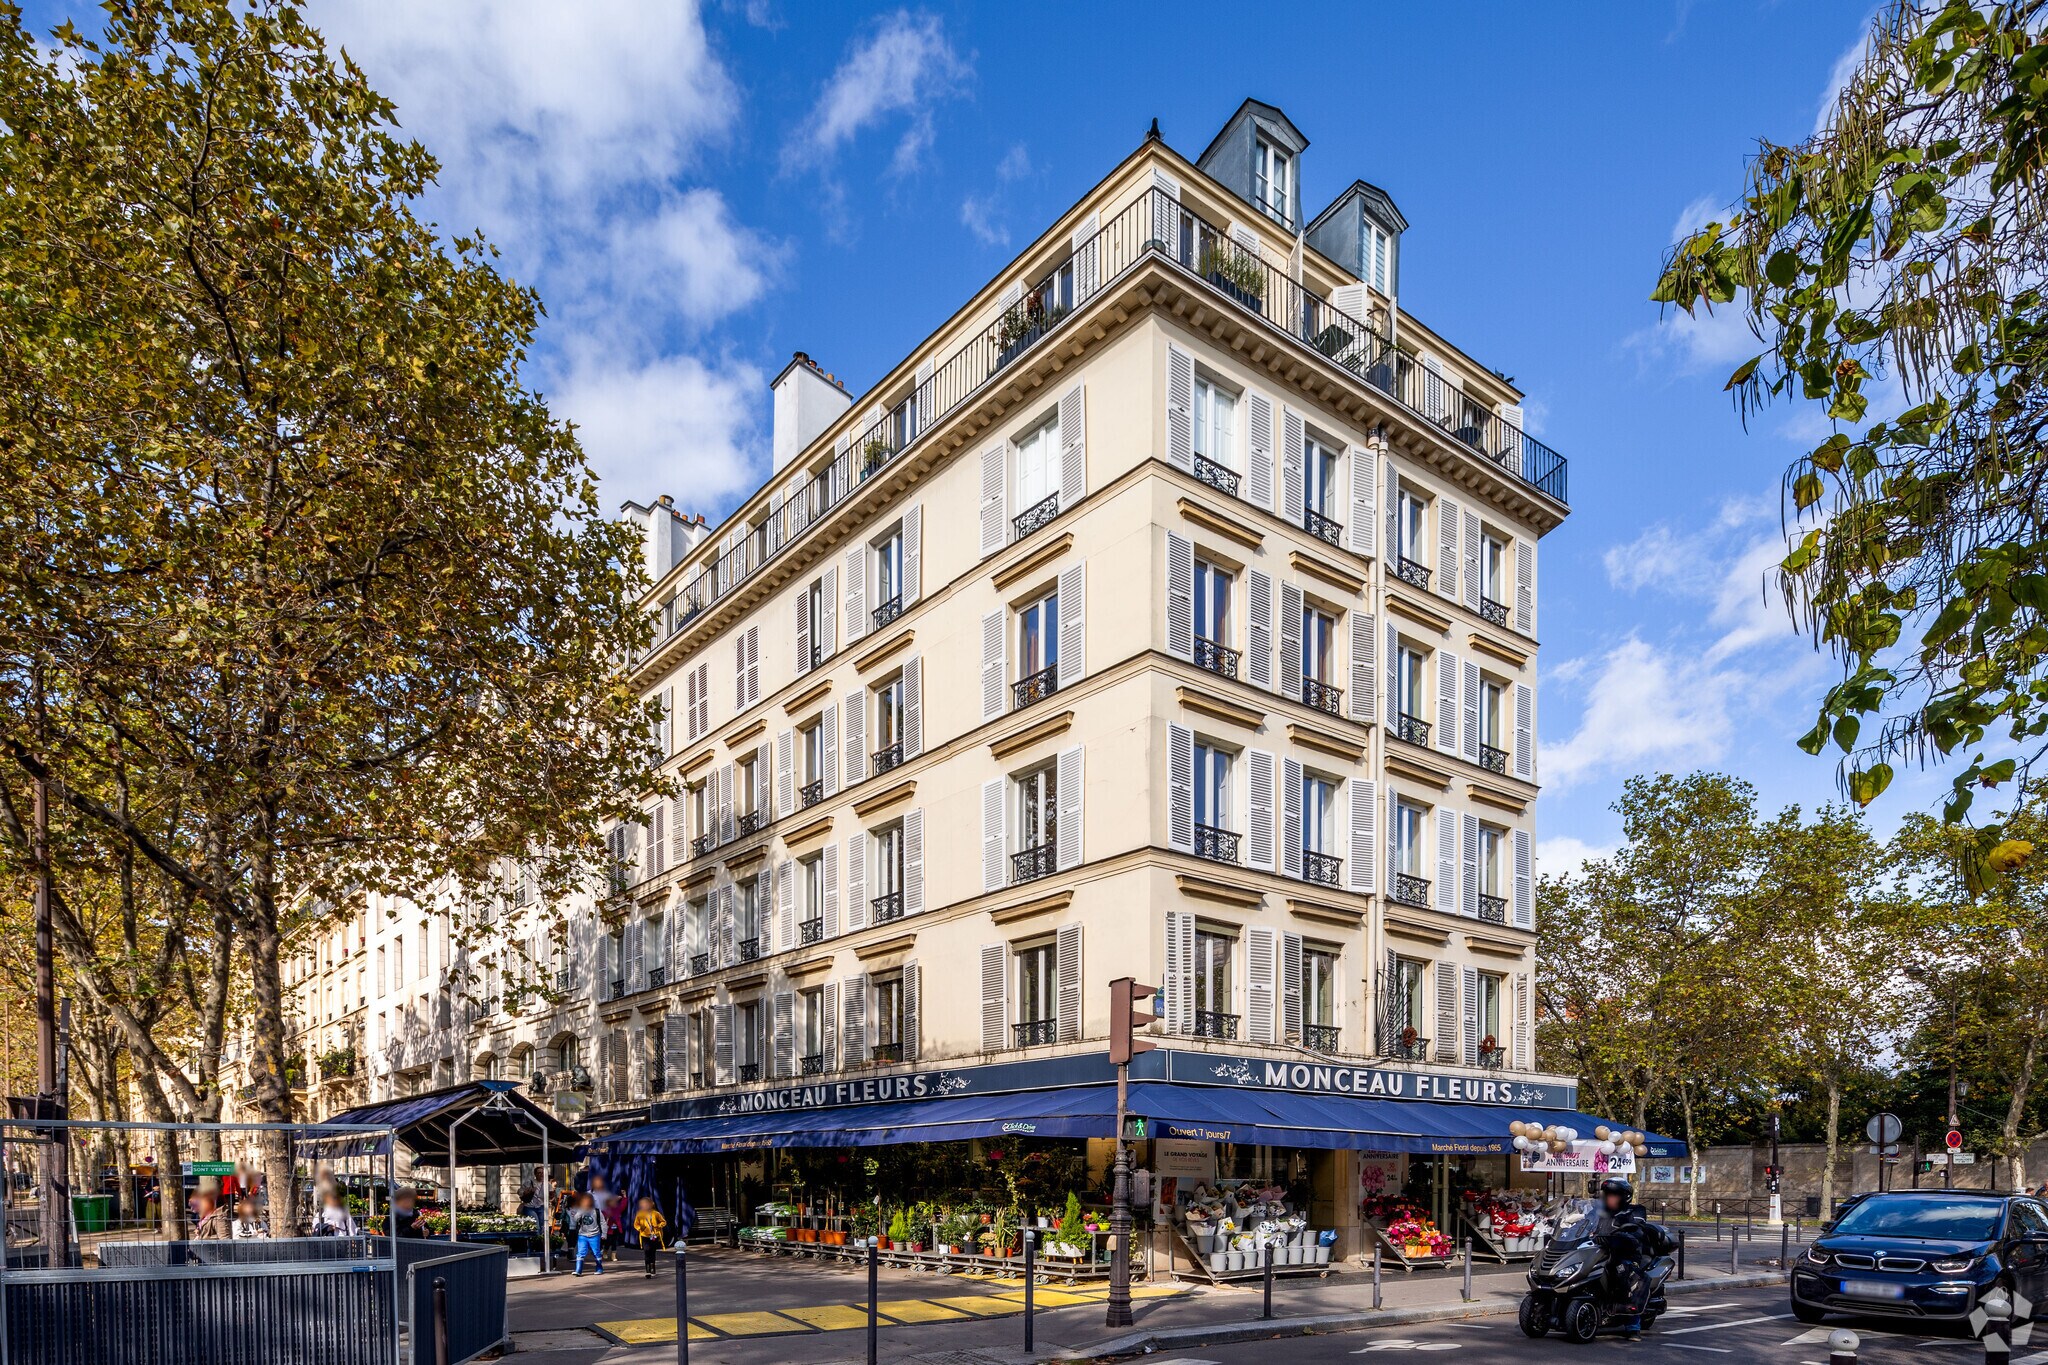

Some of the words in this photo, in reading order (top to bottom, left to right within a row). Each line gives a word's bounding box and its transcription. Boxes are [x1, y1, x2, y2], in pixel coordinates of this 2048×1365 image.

[1265, 1062, 1403, 1096] MONCEAU
[1416, 1076, 1513, 1103] FLEURS
[740, 1086, 827, 1112] MONCEAU
[836, 1075, 928, 1104] FLEURS
[1169, 1126, 1198, 1136] Ouvert
[1198, 1128, 1204, 1137] 7
[1204, 1129, 1231, 1140] jours/7
[1431, 1143, 1453, 1152] Marché
[1453, 1143, 1469, 1152] Floral
[1469, 1144, 1487, 1153] depuis
[1488, 1143, 1502, 1152] 1965
[1546, 1159, 1589, 1168] ANNIVERSAIRE
